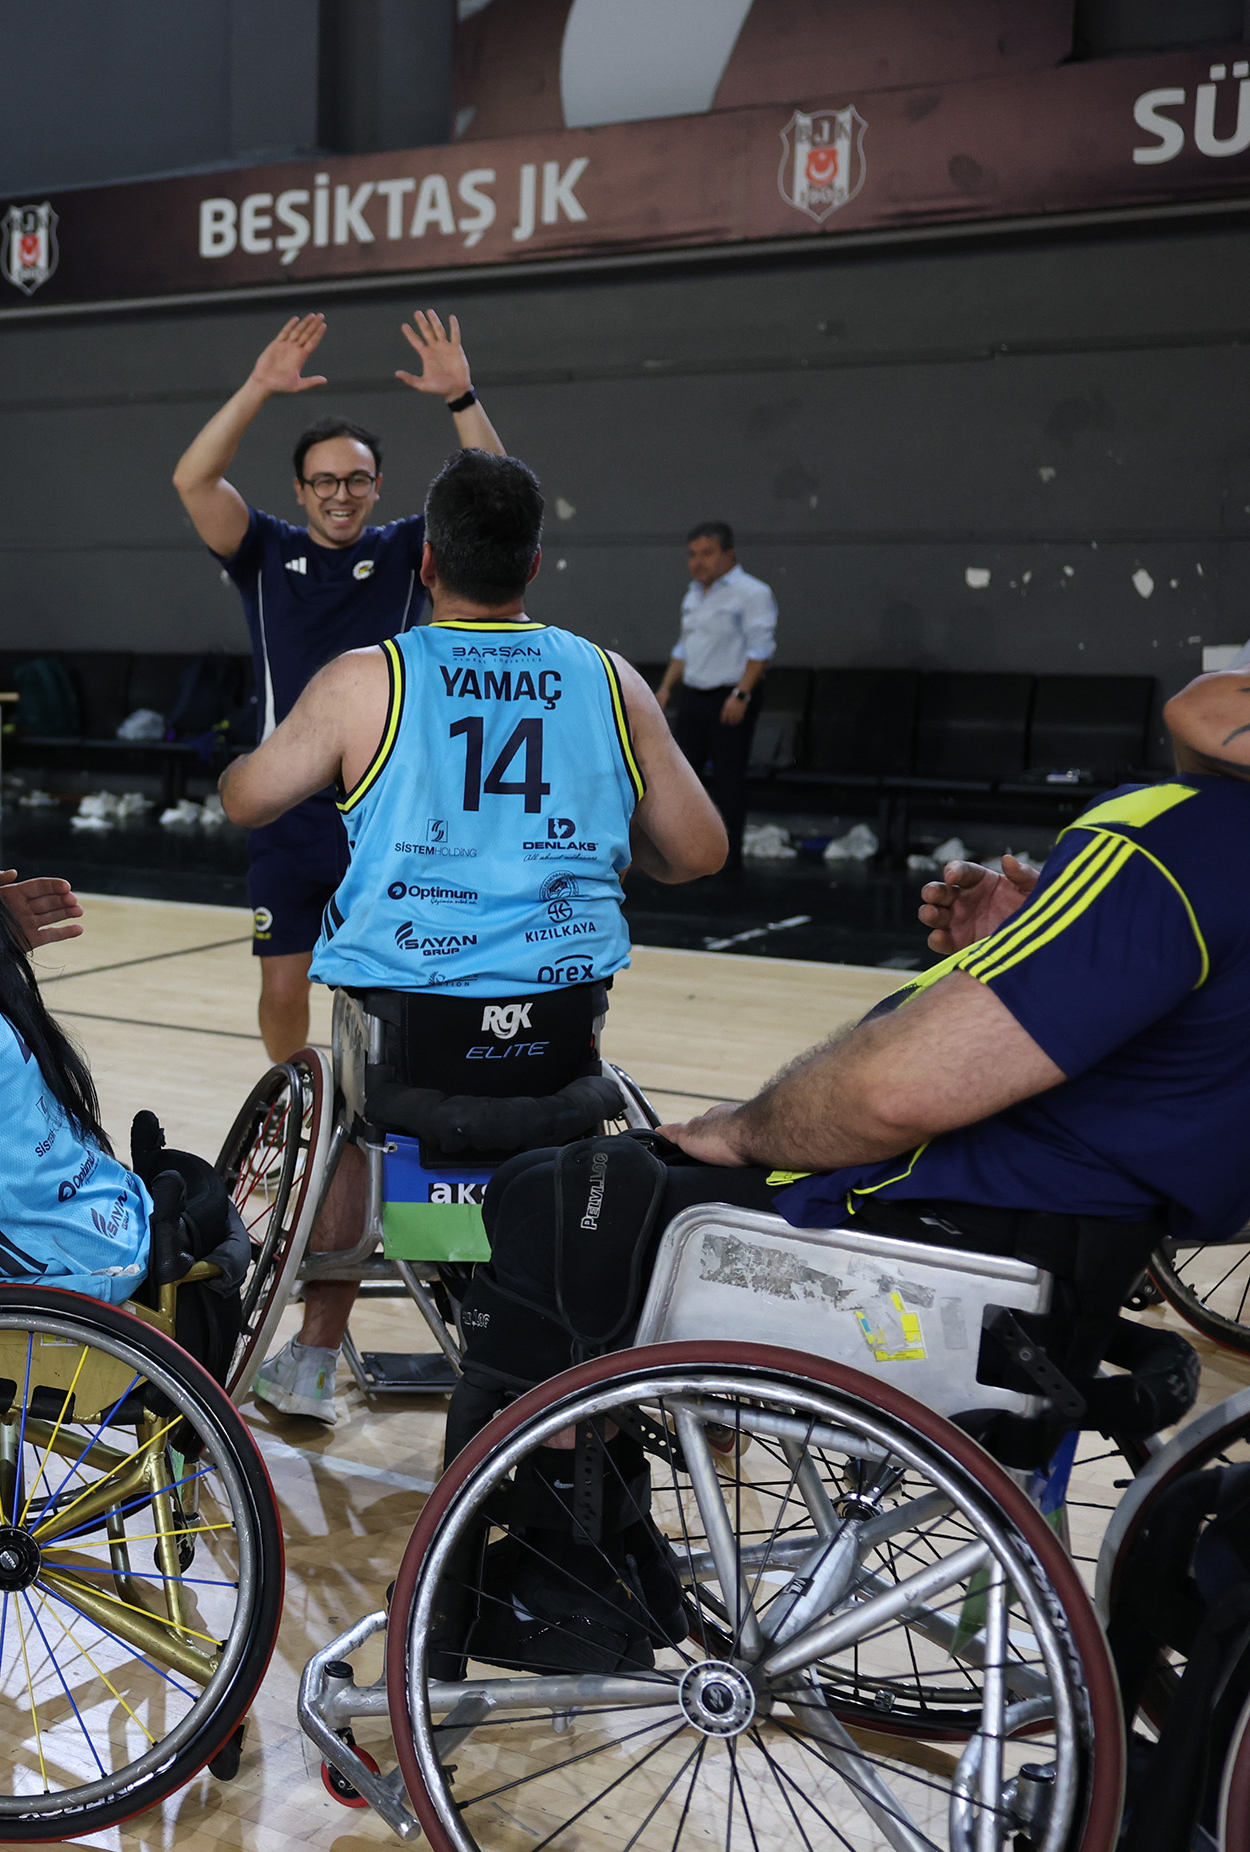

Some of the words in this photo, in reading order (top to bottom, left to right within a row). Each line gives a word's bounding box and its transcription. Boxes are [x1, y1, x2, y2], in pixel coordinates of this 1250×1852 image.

[198, 169, 497, 265] BEŞİKTAŞ
[512, 157, 590, 240] JK
[452, 646, 541, 658] BARSAN
[439, 665, 562, 710] YAMAÇ
[449, 716, 550, 813] 14
[522, 841, 597, 851] DENLAKS
[408, 885, 478, 900] Optimum
[525, 921, 597, 943] KIZILKAYA
[405, 934, 478, 950] SAYAN
[423, 947, 460, 956] GRUP
[481, 1003, 533, 1039] RGK
[465, 1041, 550, 1059] ELITE
